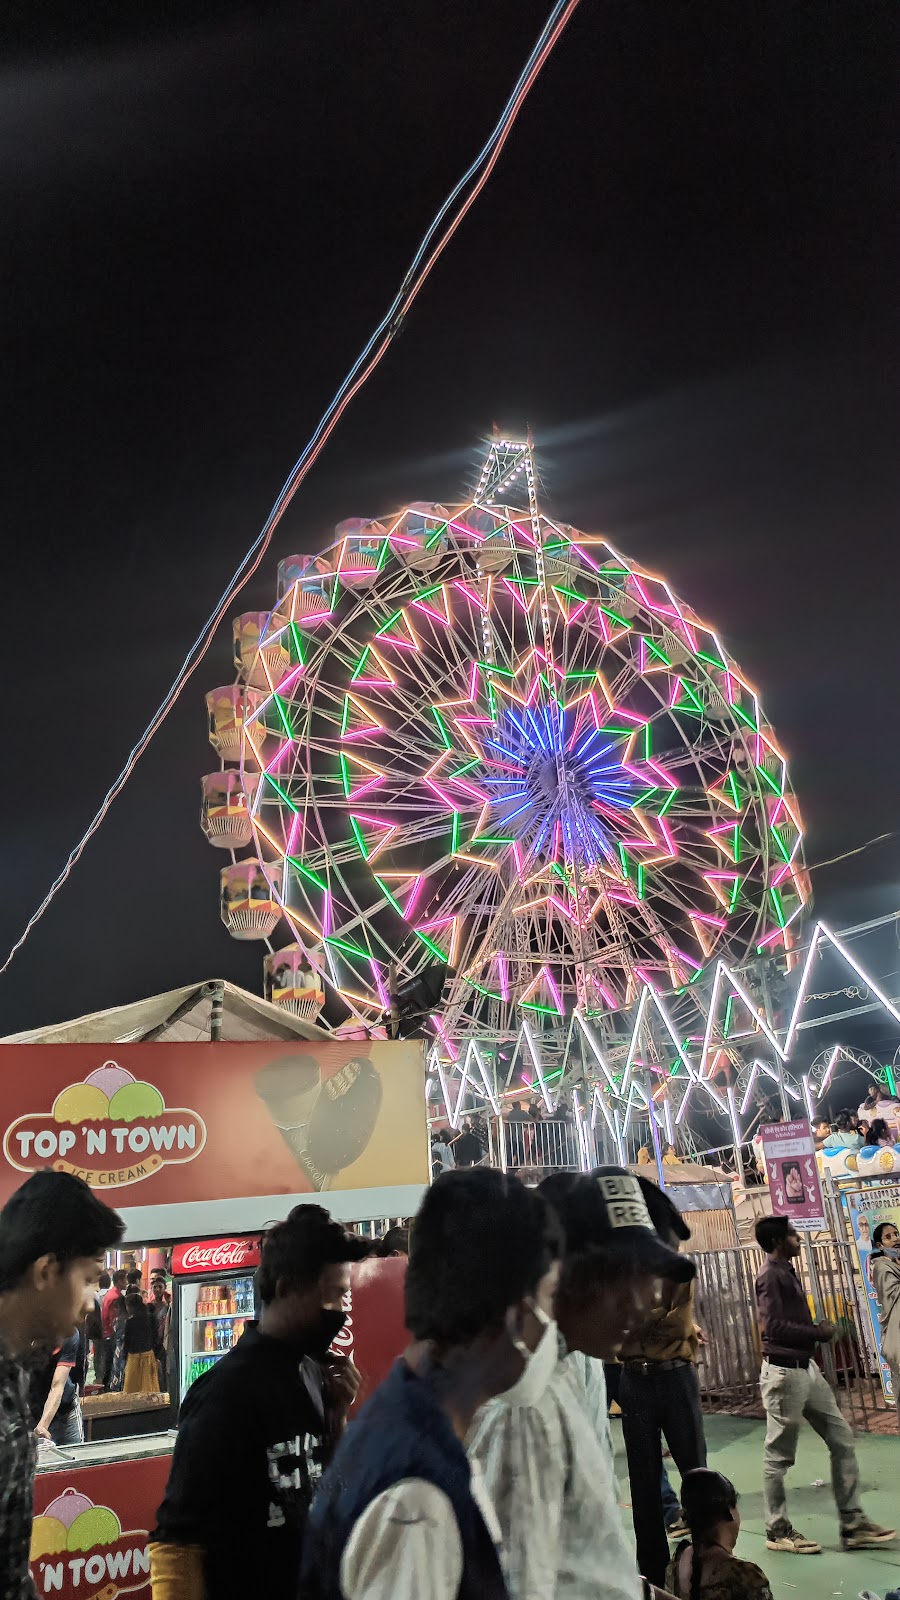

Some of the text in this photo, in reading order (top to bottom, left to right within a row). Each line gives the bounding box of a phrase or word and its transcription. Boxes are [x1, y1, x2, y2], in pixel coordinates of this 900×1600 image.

[16, 1124, 196, 1158] TOP 'N TOWN
[98, 1164, 147, 1185] CREAM
[181, 1240, 250, 1269] Coca-Cola
[68, 1547, 150, 1587] TOWN
